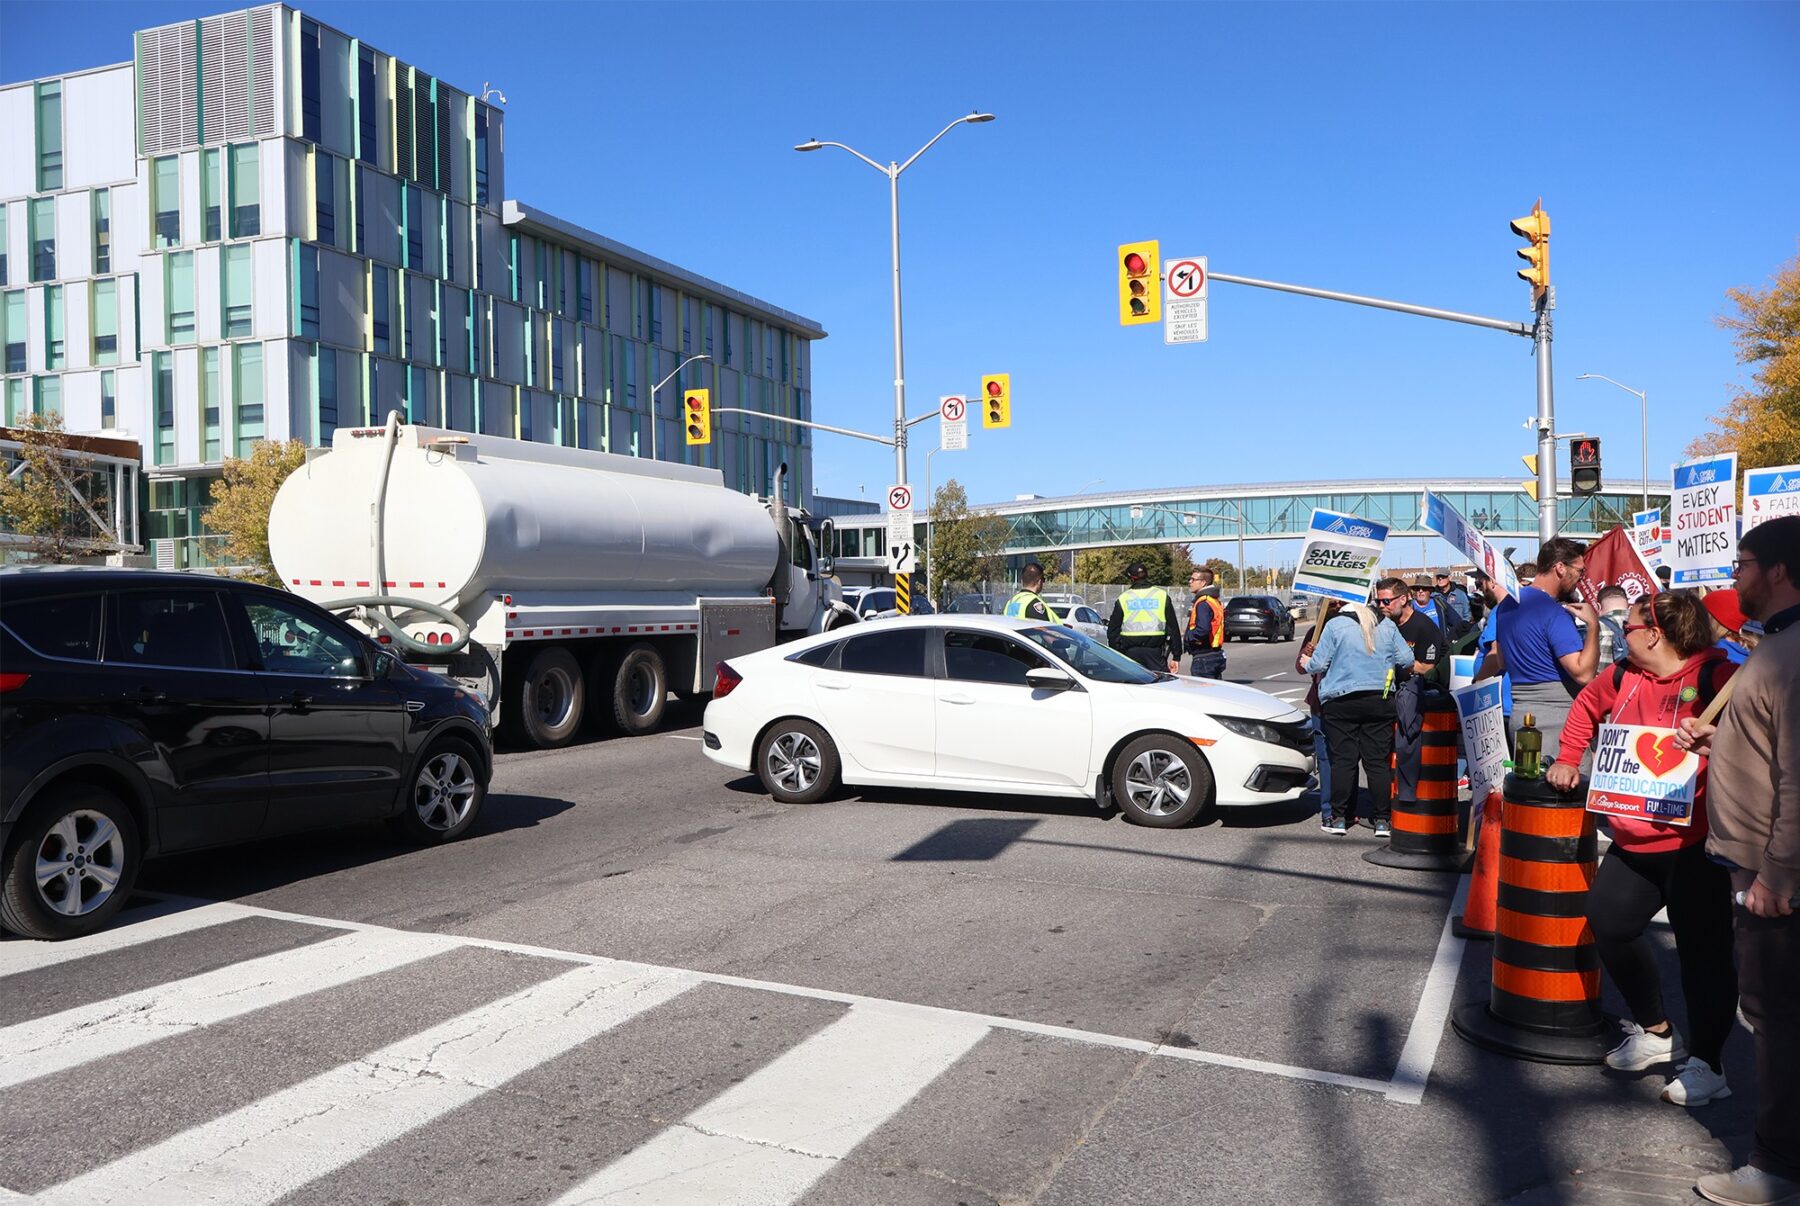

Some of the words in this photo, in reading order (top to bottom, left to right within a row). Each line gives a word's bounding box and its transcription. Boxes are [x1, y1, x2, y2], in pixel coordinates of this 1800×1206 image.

[1682, 486, 1719, 508] EVERY
[1769, 496, 1799, 510] FAIR
[1677, 505, 1733, 530] STUDENT
[1309, 549, 1352, 560] SAVE
[1677, 531, 1729, 558] MATTERS
[1127, 599, 1159, 610] POLICE
[1465, 706, 1502, 739] STUDENT
[1601, 729, 1630, 747] DON'T
[1597, 747, 1626, 773] CUT
[1621, 758, 1640, 774] the
[1594, 774, 1608, 789] OUT
[1607, 776, 1619, 790] OF
[1619, 777, 1689, 799] EDUCATION
[1613, 801, 1640, 812] Support
[1646, 801, 1684, 816] FULL-TIME
